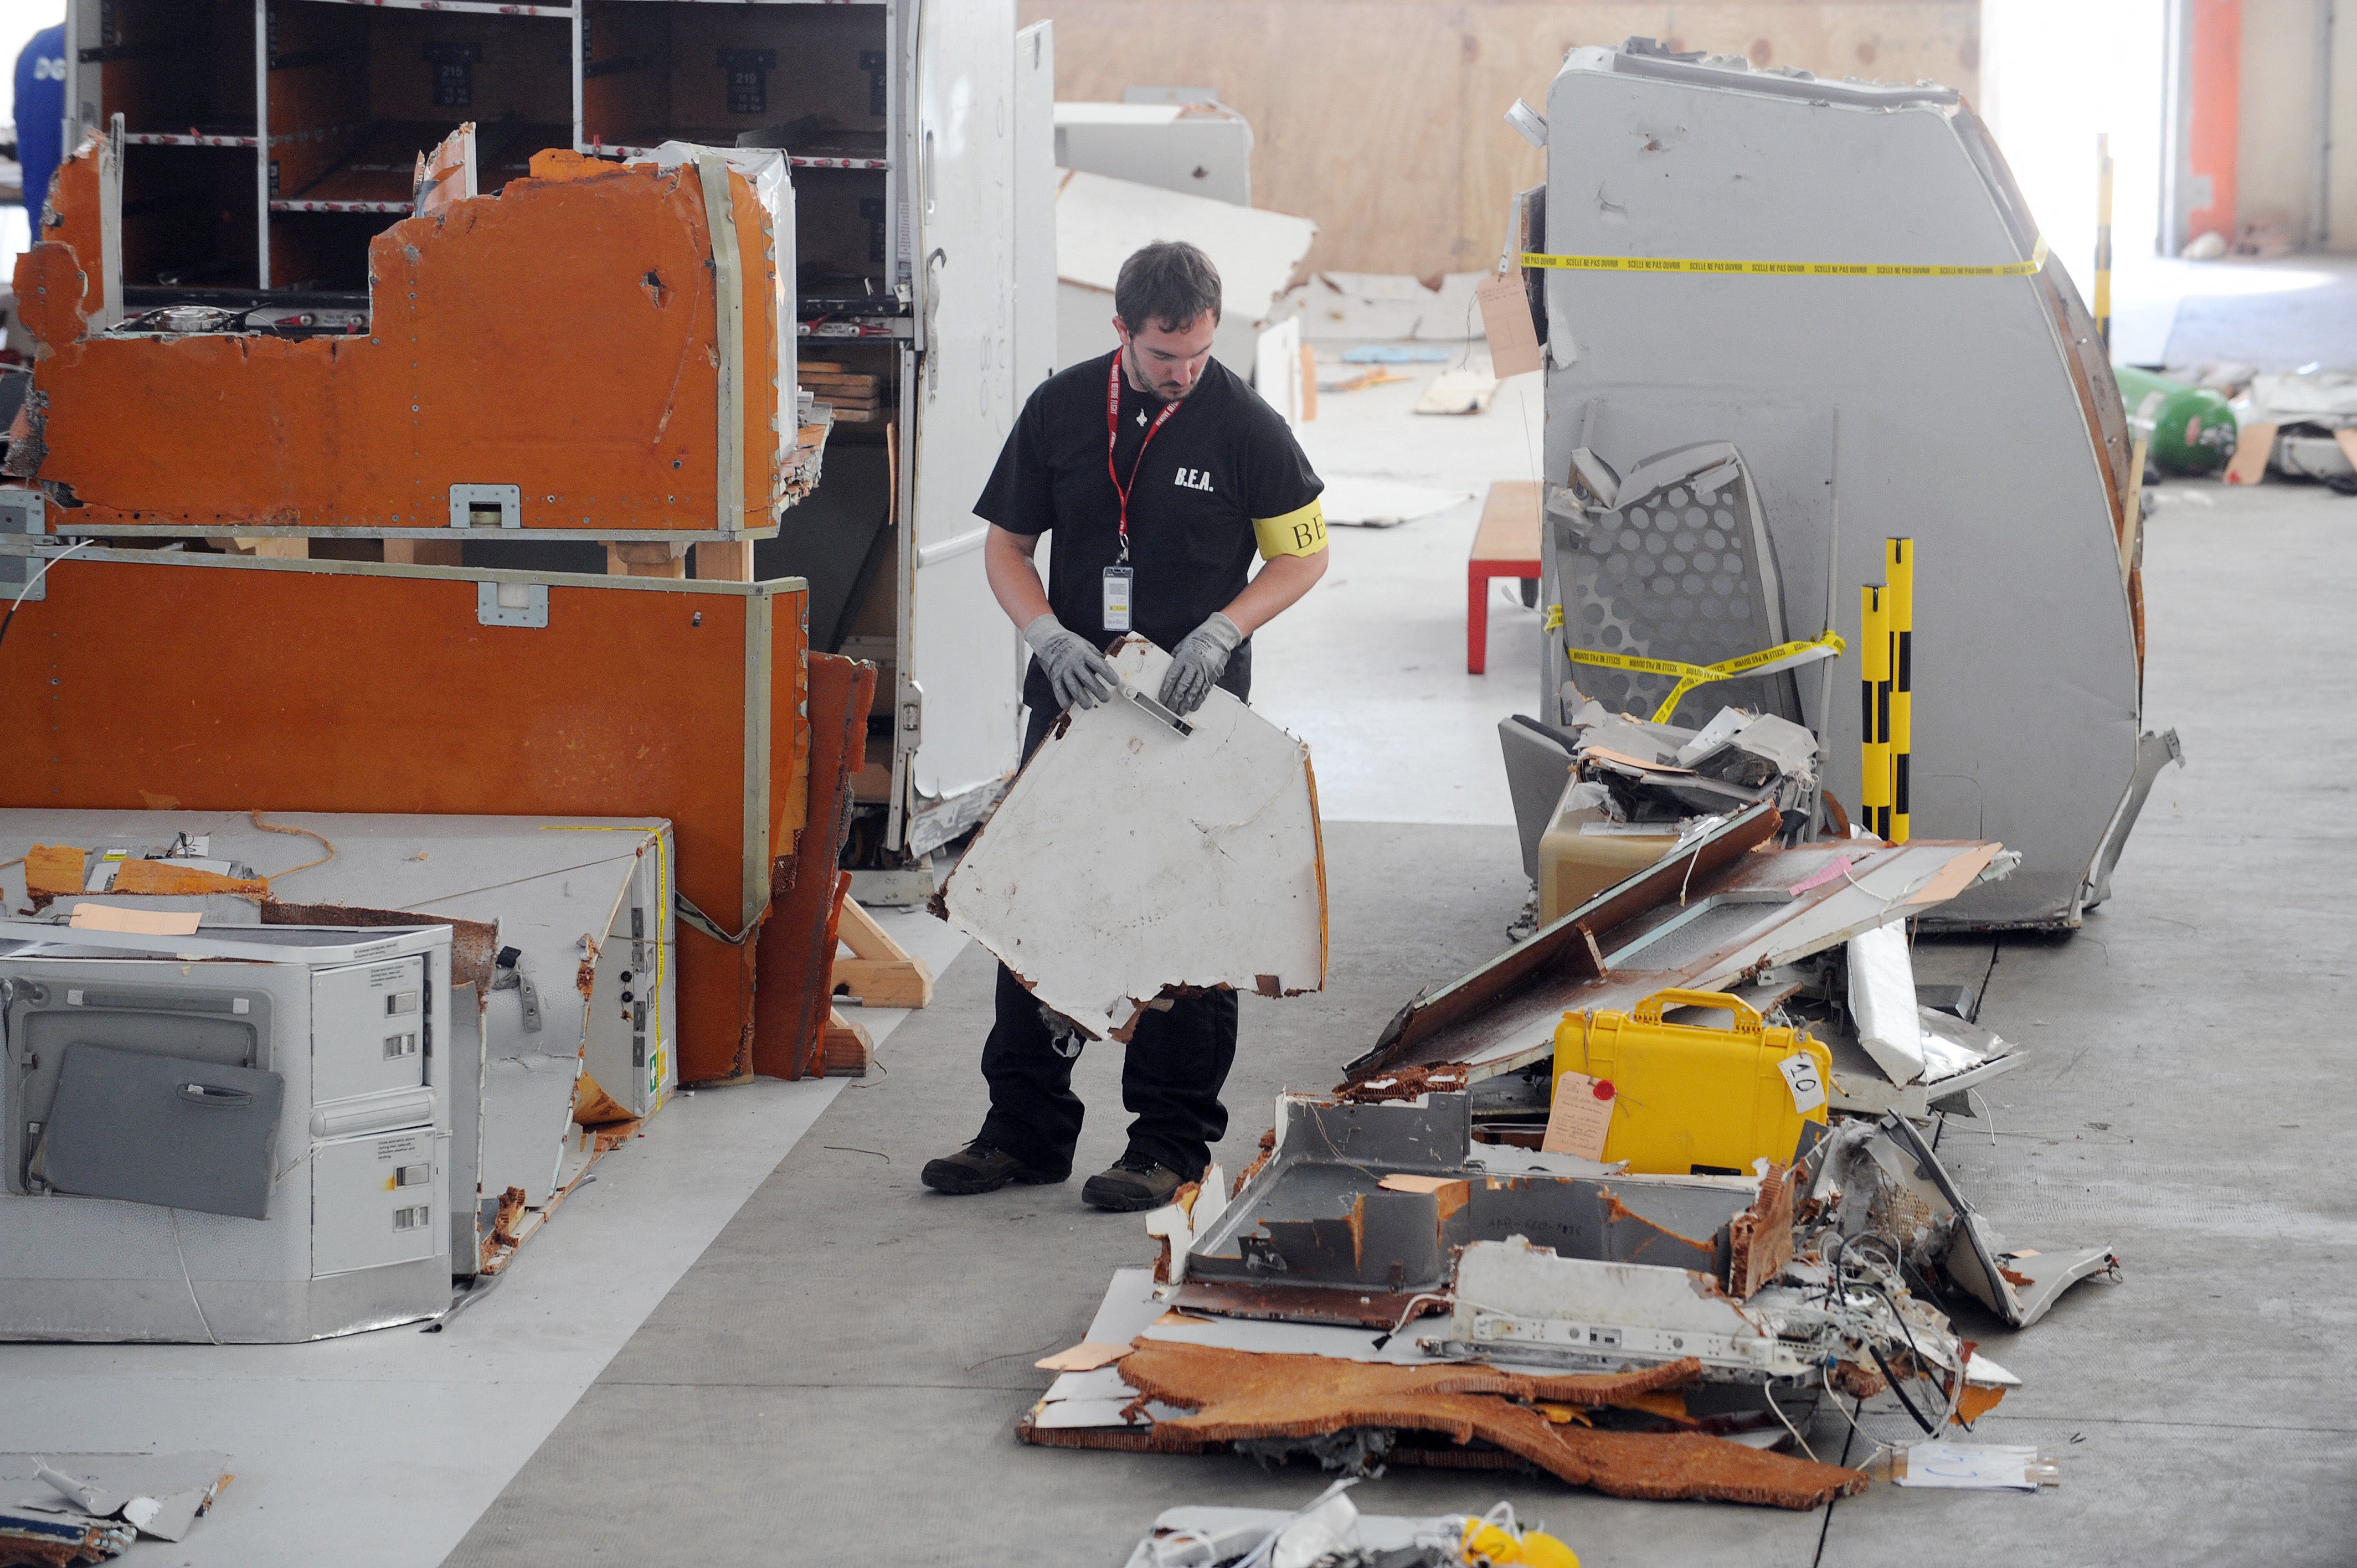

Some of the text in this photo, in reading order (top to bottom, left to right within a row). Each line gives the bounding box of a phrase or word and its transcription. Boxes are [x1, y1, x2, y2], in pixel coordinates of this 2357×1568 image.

[1531, 256, 1540, 265] PAS
[1540, 257, 1557, 266] OUVRIR
[1566, 258, 1582, 266] SCELLE
[1601, 259, 1618, 267] OUVRIR
[1628, 260, 1644, 269] SCELLE
[1652, 261, 1661, 269] PAS
[1663, 261, 1680, 270] OUVRIR
[1690, 262, 1706, 270] SCELLE
[1714, 262, 1723, 271] PAS
[1769, 264, 1776, 272] NE
[1814, 265, 1830, 273] SCELLE
[1839, 265, 1849, 274] PAS
[1850, 265, 1867, 274] OUVRIR
[1912, 266, 1929, 275] OUVRIR
[1110, 382, 1119, 399] BEFORE
[1174, 467, 1214, 492] B.E.A.
[1574, 653, 1589, 662] OUVRIR
[1768, 648, 1785, 659] SCELLE
[1605, 657, 1621, 666] SCELLE
[1629, 659, 1645, 668] OUVRIR
[1733, 658, 1752, 668] OUVRIR
[1751, 656, 1762, 664] PAS
[1646, 662, 1655, 670] PAS
[1661, 663, 1677, 672] SCELLE
[1789, 1064, 1816, 1092] 10
